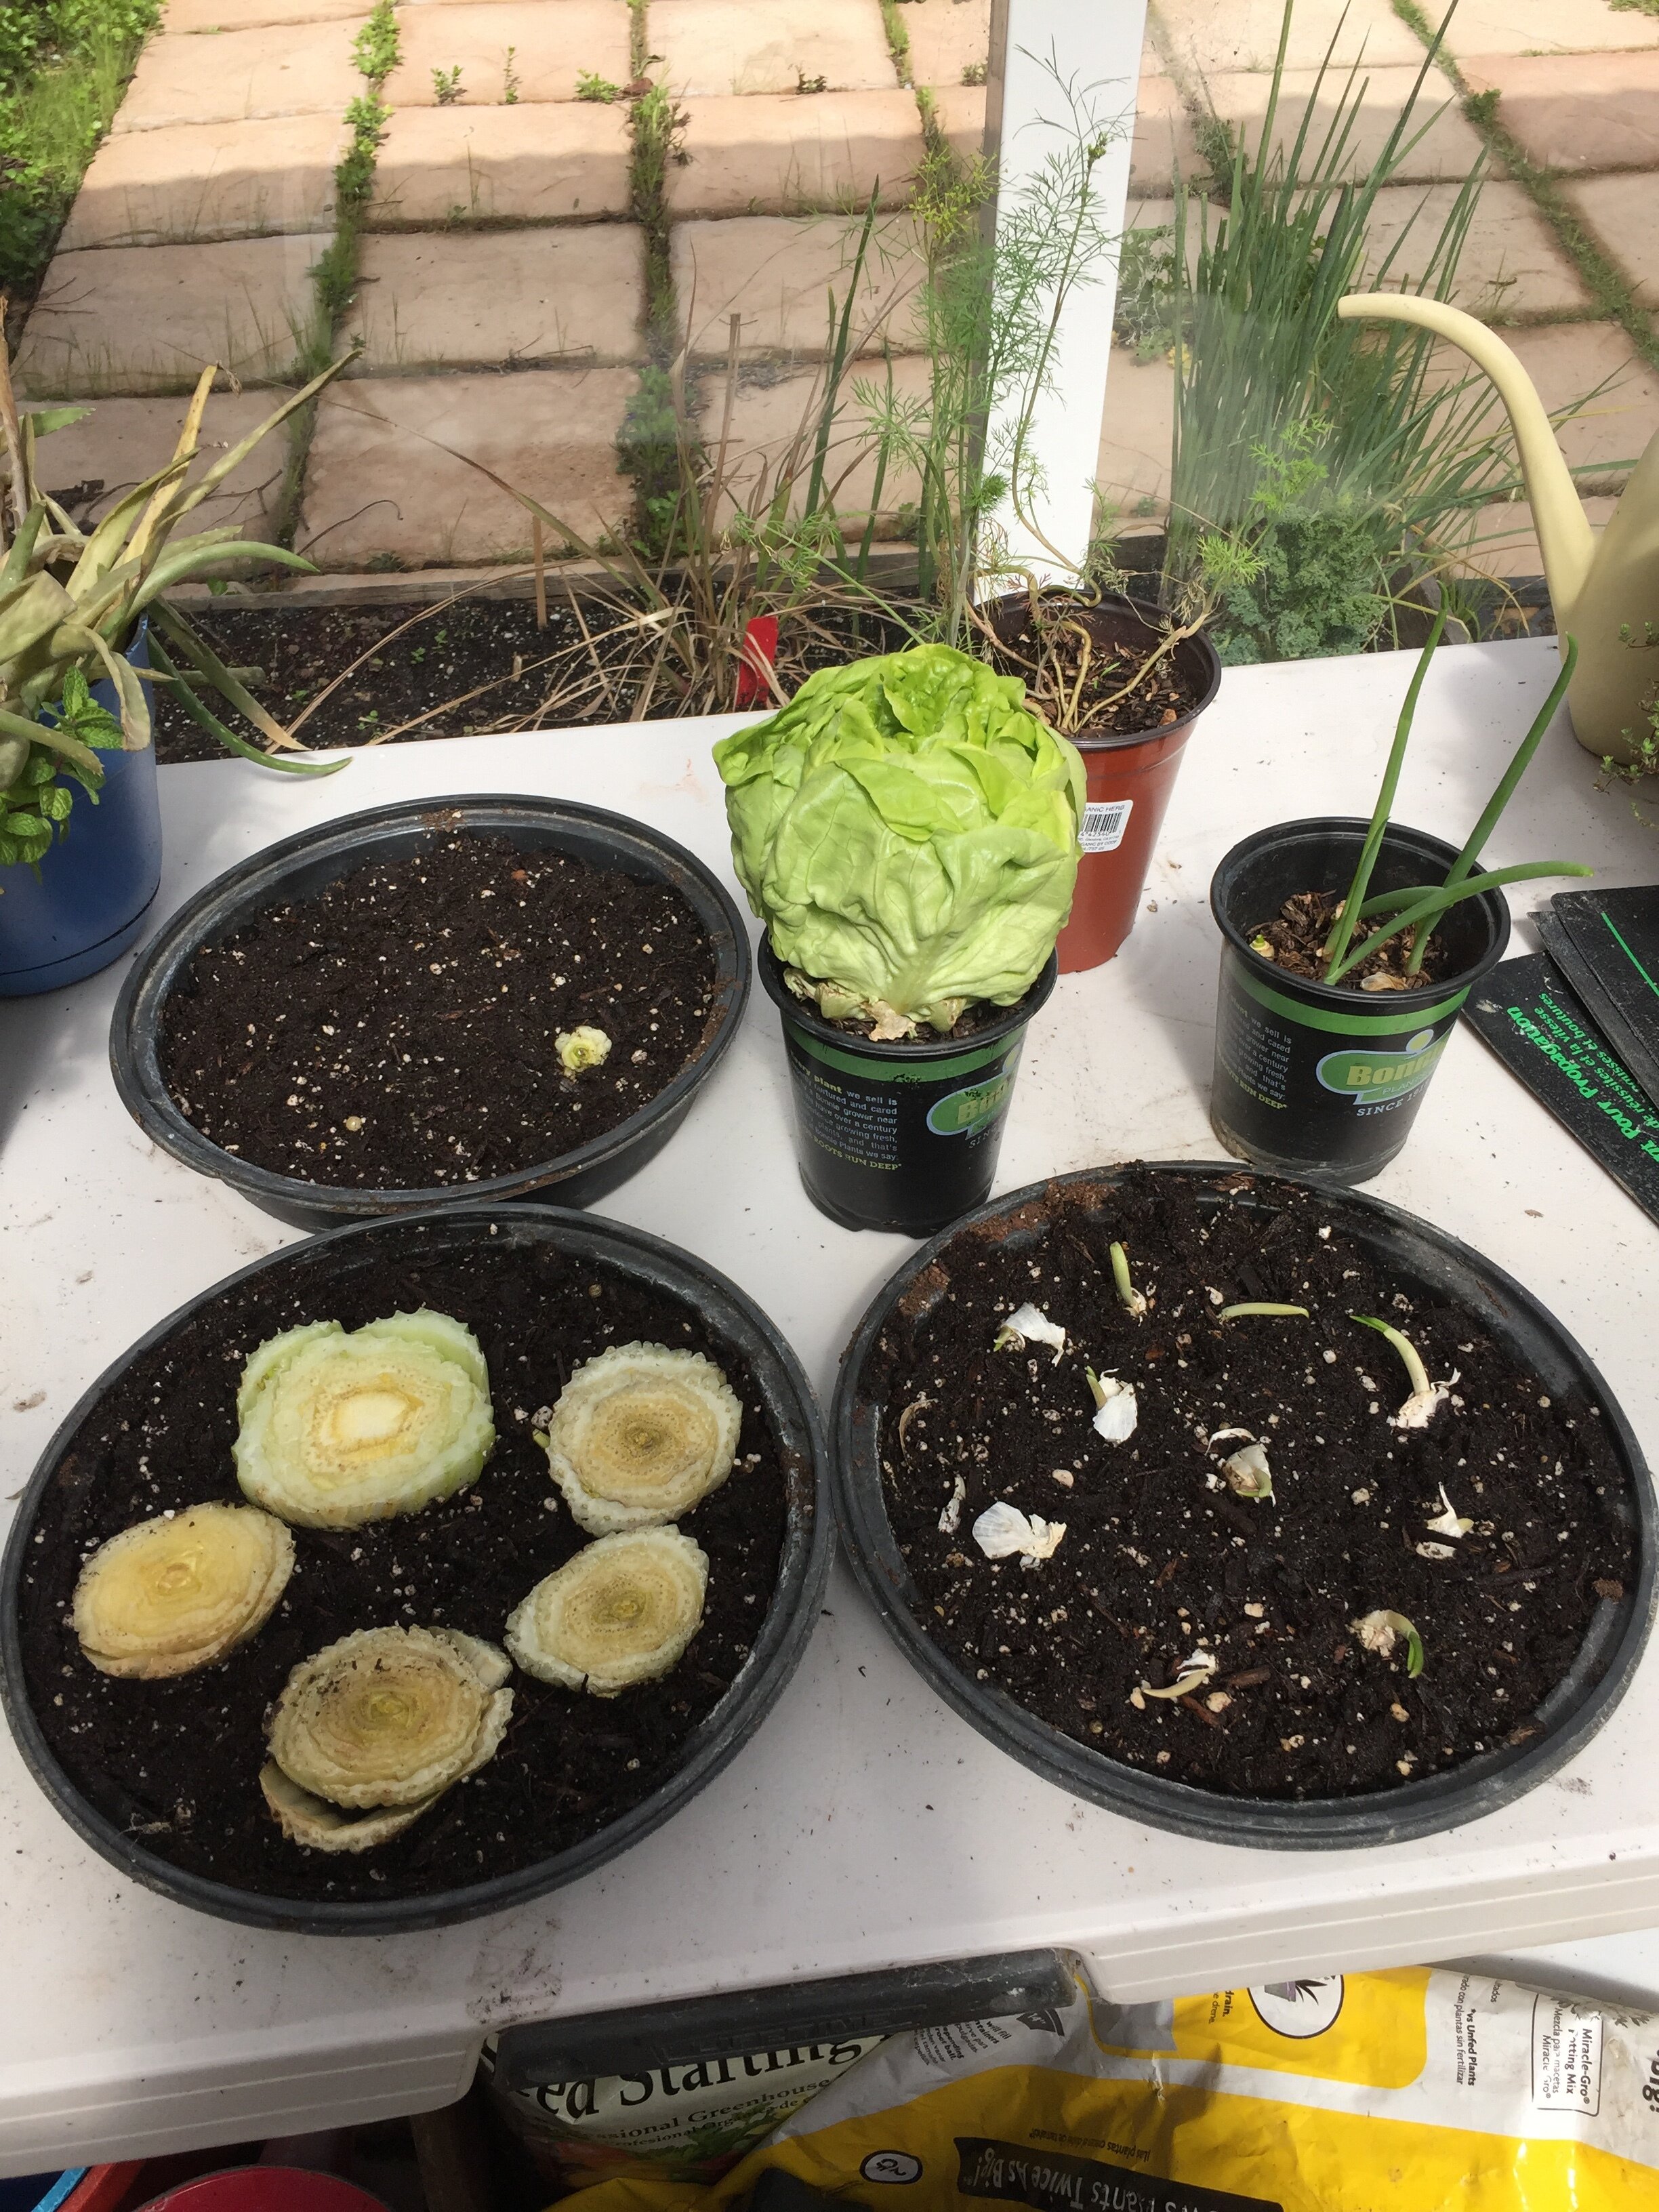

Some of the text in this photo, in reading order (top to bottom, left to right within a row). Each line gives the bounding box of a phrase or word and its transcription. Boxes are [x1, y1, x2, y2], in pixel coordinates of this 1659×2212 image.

[1534, 1007, 1570, 1042] vitesse
[1539, 994, 1586, 1039] boutures
[1250, 1017, 1261, 1028] we
[1265, 1026, 1280, 1039] sell
[1284, 1035, 1292, 1044] is
[1252, 1026, 1265, 1042] and
[1267, 1039, 1291, 1054] cared
[1246, 1033, 1290, 1063] grower near
[1507, 1006, 1599, 1099] Propagation
[1570, 1044, 1583, 1054] la
[1582, 1038, 1598, 1050] et
[1239, 1048, 1263, 1071] growing
[1258, 1054, 1289, 1073] century
[1580, 1054, 1595, 1065] et
[814, 1075, 842, 1094] plant
[846, 1090, 861, 1100] we
[865, 1096, 883, 1105] sell
[1240, 1079, 1257, 1097] RUN
[1245, 1064, 1286, 1090] and that's
[1257, 1082, 1268, 1092] we
[1595, 1067, 1645, 1113] réussites
[844, 1107, 874, 1121] grower
[850, 1101, 867, 1111] and
[871, 1106, 897, 1115] cared
[1357, 1099, 1404, 1117] SINCE
[1597, 1101, 1641, 1139] Pour
[834, 1113, 851, 1124] over
[862, 1122, 898, 1135] century
[836, 1123, 898, 1143] growing fresh,
[813, 1136, 842, 1158] ROOTS
[844, 1154, 868, 1166] RUN
[840, 1141, 864, 1155] Plants
[866, 1150, 879, 1158] we
[848, 1137, 865, 1146] and
[871, 1141, 898, 1151] that's
[1458, 1991, 1466, 2003] con
[986, 2021, 1001, 2032] will
[1454, 2004, 1465, 2034] plantas
[1553, 2007, 1563, 2036] Mezcla
[935, 2028, 947, 2045] root
[1456, 2035, 1465, 2047] sin
[1467, 2025, 1477, 2055] Unfed
[1456, 2049, 1467, 2085] fertilizar
[1468, 2056, 1478, 2087] Plants
[1552, 2060, 1560, 2093] macetas
[1566, 2074, 1576, 2094] Mix
[688, 2078, 830, 2122] Greenhouse
[1107, 2142, 1136, 2160] plantas
[972, 2148, 1005, 2188] Big!
[1008, 2160, 1029, 2192] As
[1031, 2166, 1084, 2210] Twice
